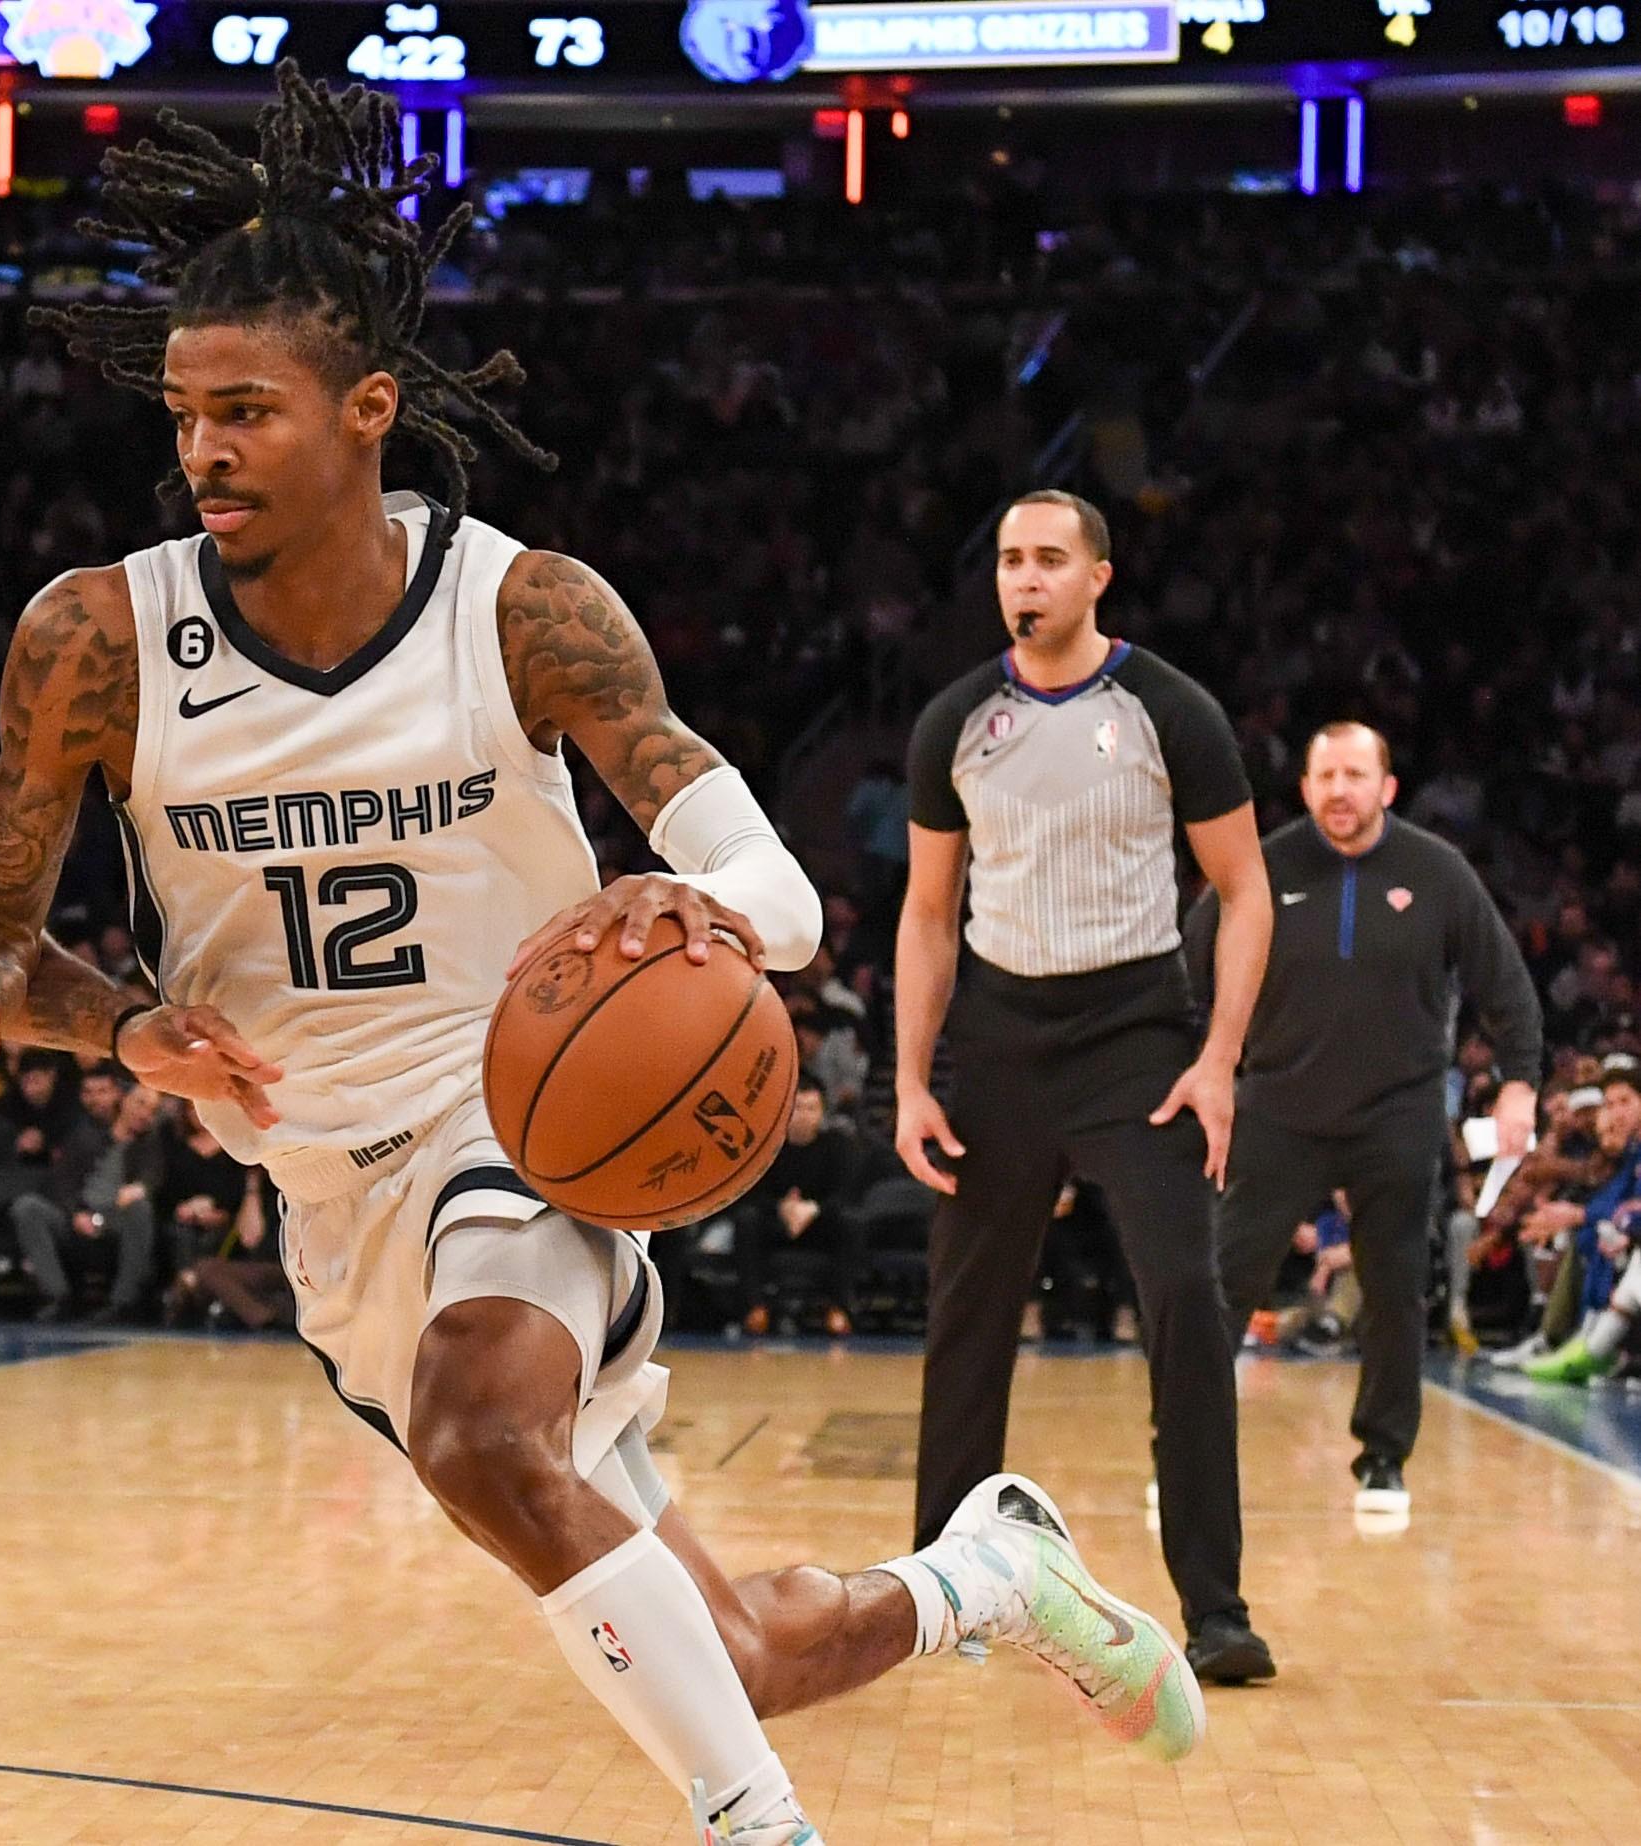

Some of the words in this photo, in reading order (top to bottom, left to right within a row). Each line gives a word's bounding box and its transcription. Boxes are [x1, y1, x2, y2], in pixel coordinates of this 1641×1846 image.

[212, 14, 289, 65] 67
[347, 34, 466, 80] 4:22
[528, 17, 605, 67] 73
[816, 14, 976, 54] MEMPHIS
[978, 10, 1149, 51] GRIZZLIES
[178, 622, 205, 665] 6
[164, 767, 497, 853] MEMPHIS
[262, 861, 427, 991] 12
